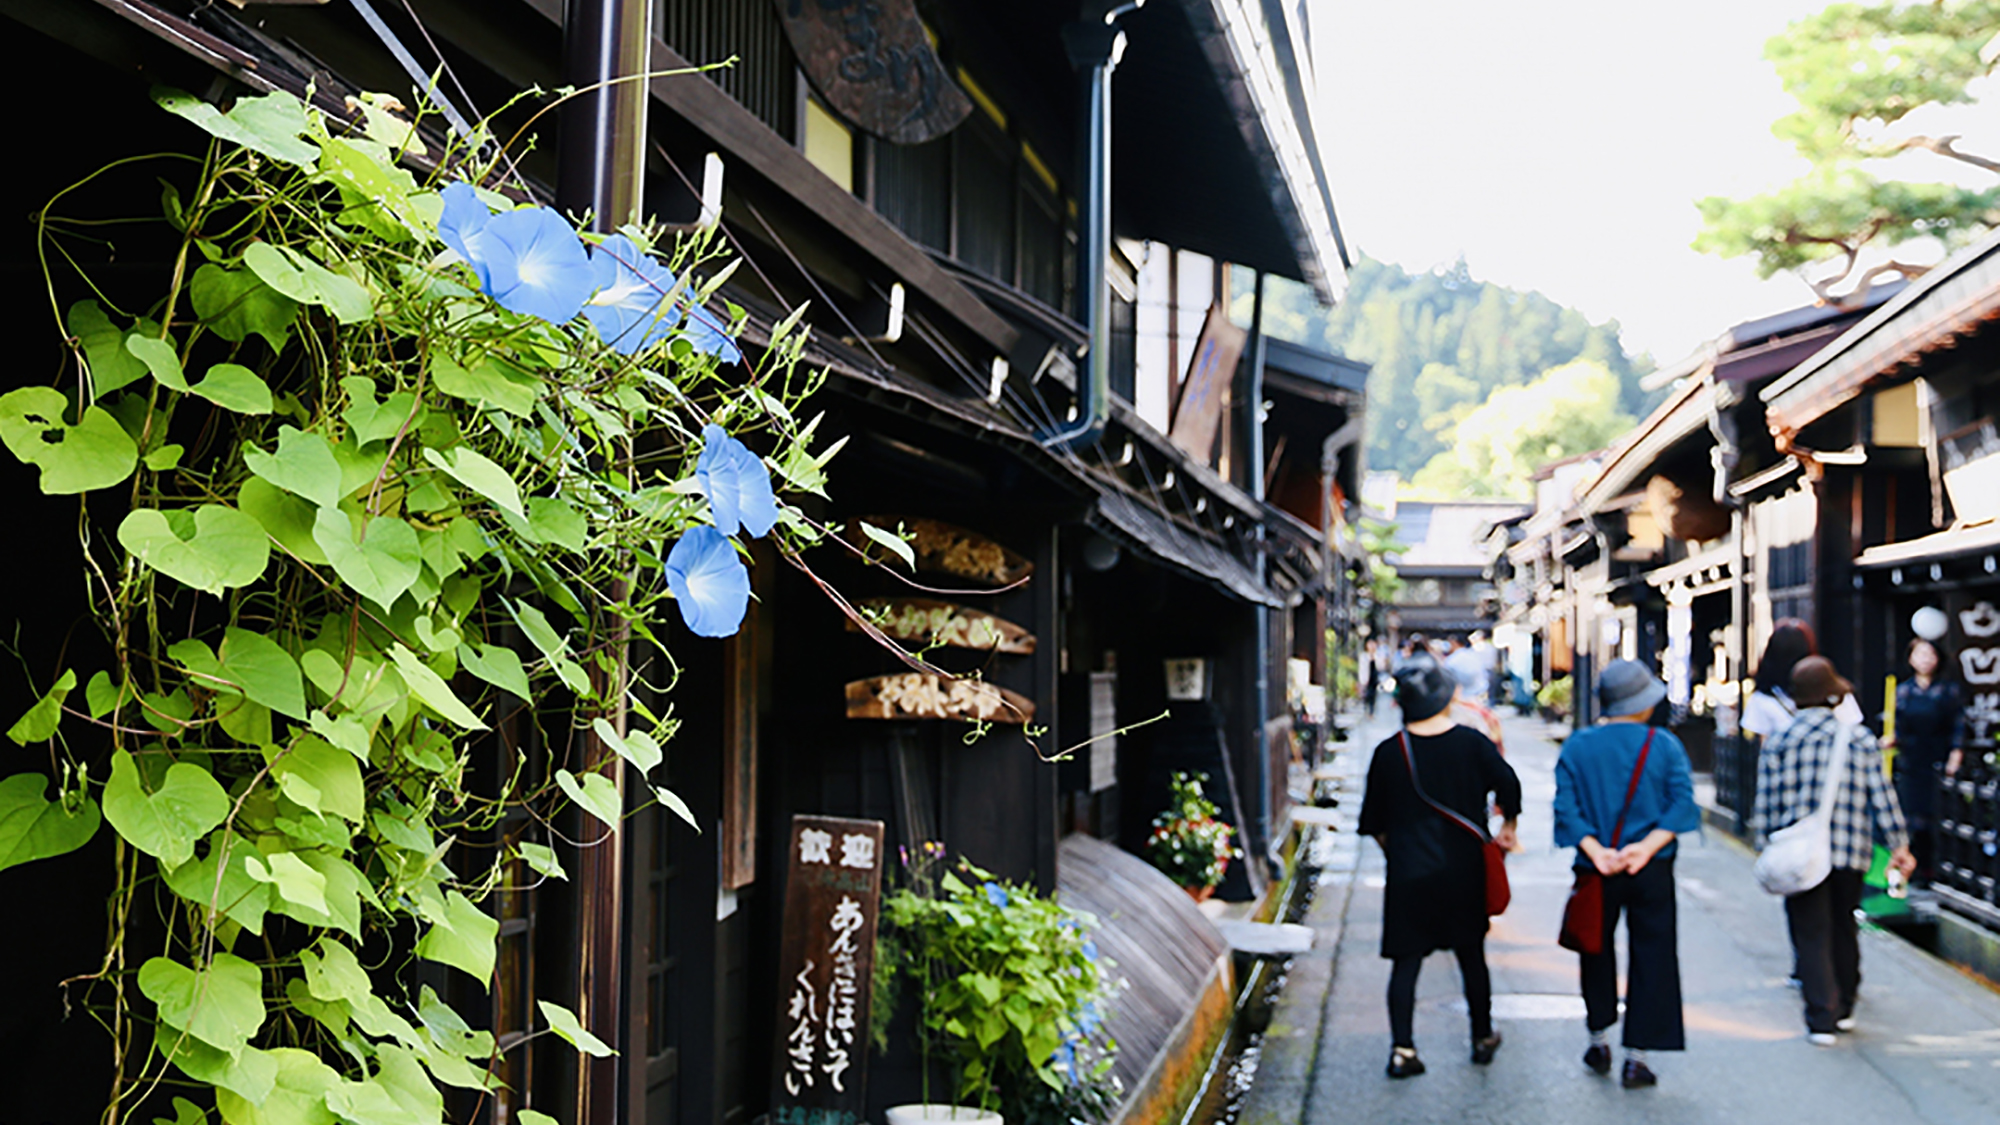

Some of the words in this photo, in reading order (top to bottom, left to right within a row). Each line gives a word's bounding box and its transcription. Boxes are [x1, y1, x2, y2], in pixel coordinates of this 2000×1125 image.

[798, 827, 876, 870] 歓迎
[784, 959, 820, 1097] くれんさい
